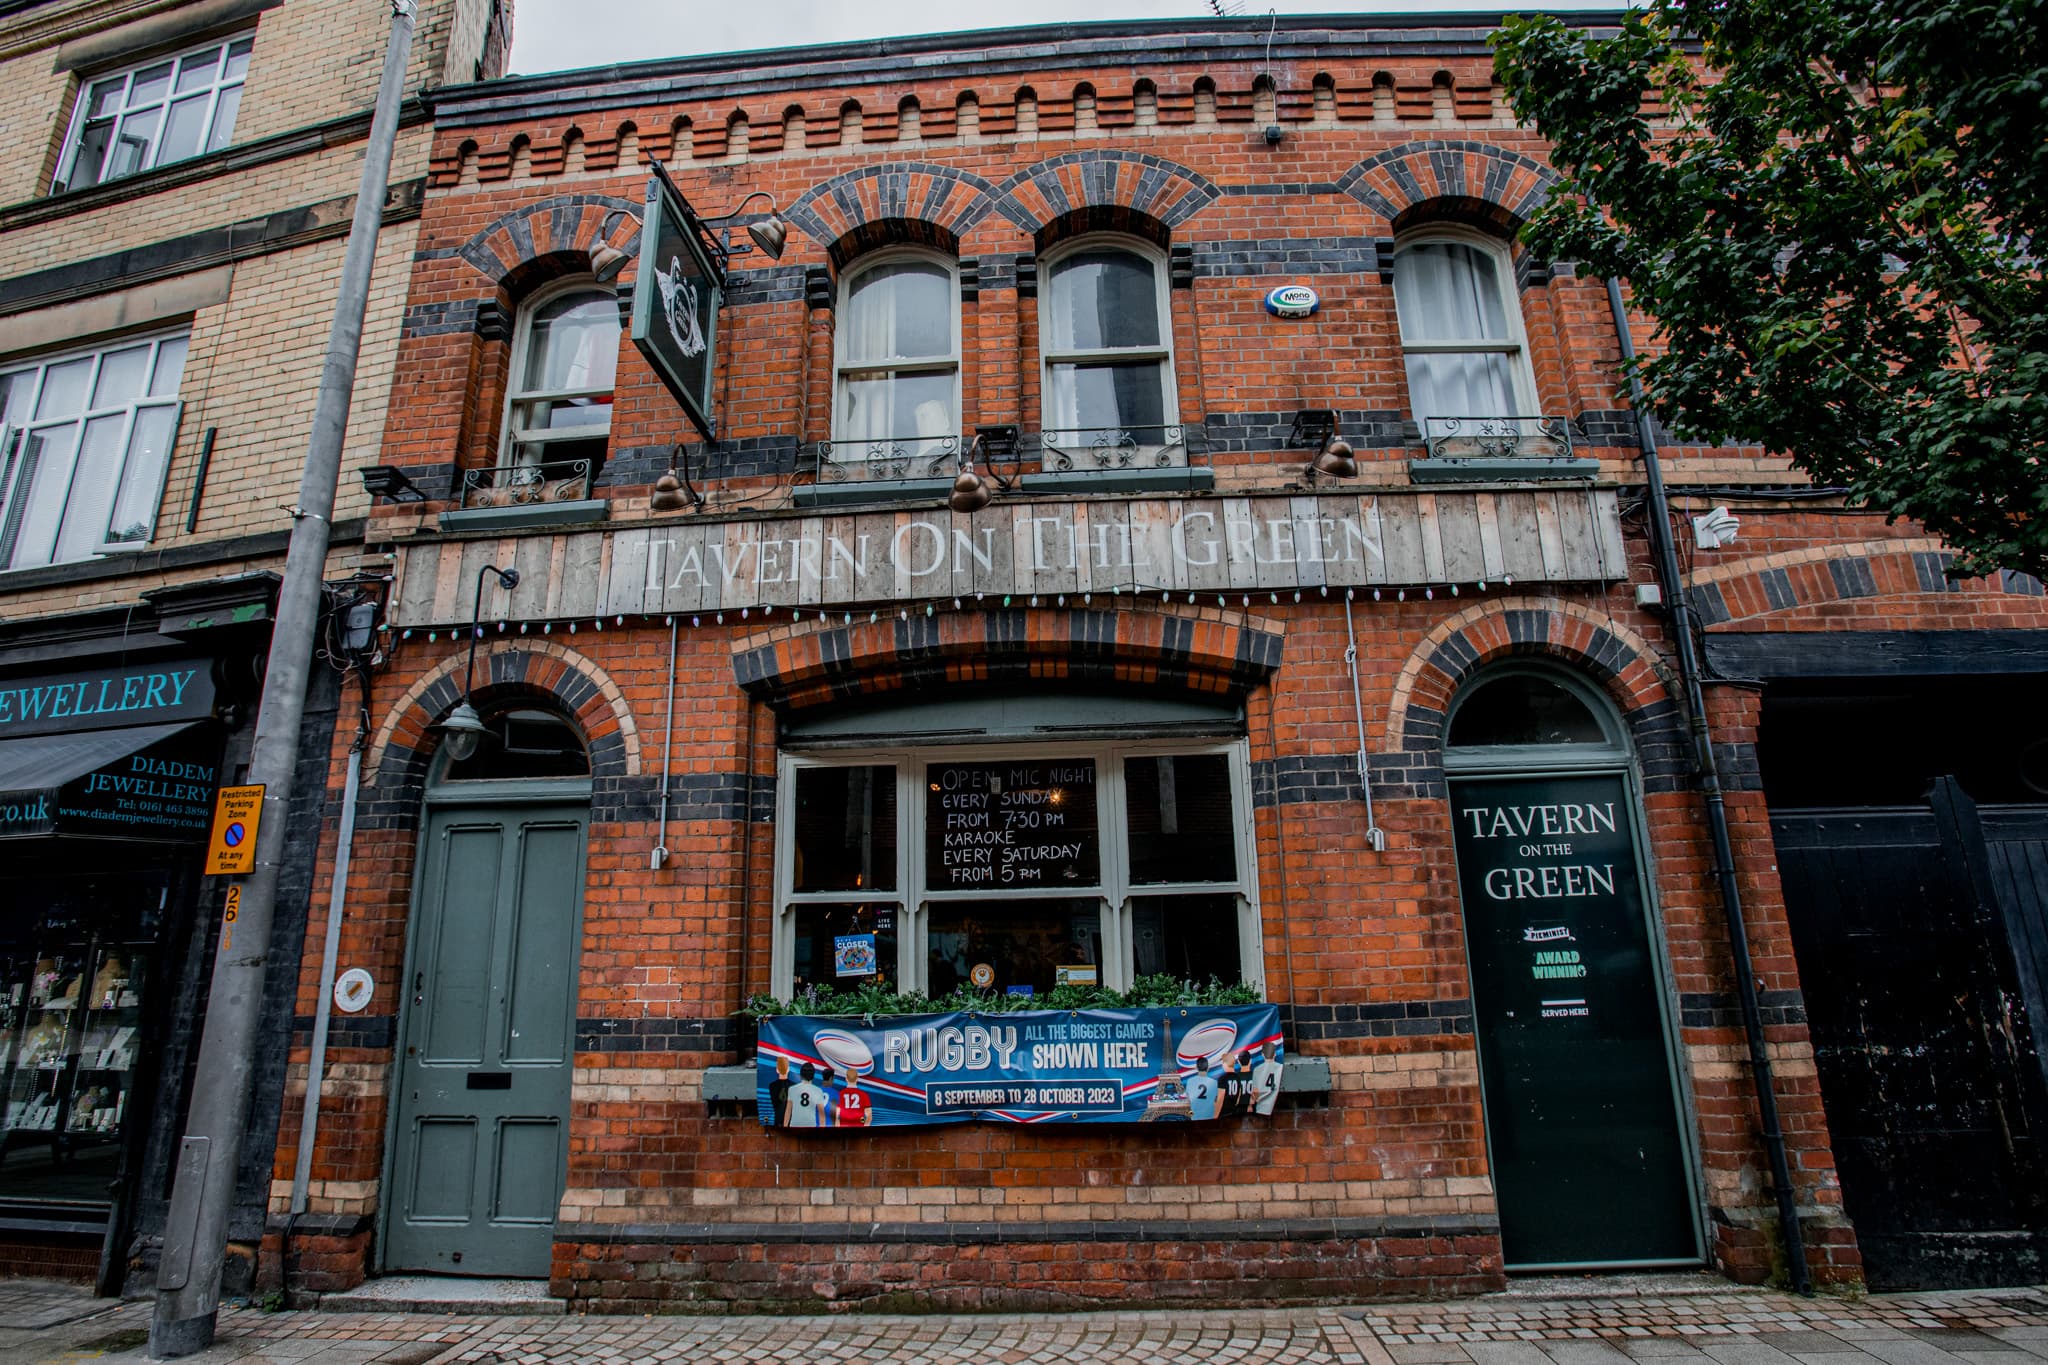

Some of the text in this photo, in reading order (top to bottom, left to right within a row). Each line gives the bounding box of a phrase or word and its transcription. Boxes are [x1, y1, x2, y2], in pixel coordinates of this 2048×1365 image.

[633, 511, 1386, 591] TAVERN ON THE GREEN
[131, 756, 214, 782] DIADEM
[943, 766, 1094, 790] OPEN MIC NIGHT
[85, 773, 212, 802] JEWELLERY
[222, 789, 262, 799] Restricted
[117, 798, 136, 810] Tel:
[139, 801, 162, 812] 0161
[165, 804, 183, 814] 465
[225, 800, 254, 809] Parking
[943, 788, 1062, 808] EVERY SUNDAY
[59, 807, 207, 829] www.diademjewellery.co.uk
[228, 810, 247, 818] Zone
[947, 810, 1064, 829] FROM 7:30 PM
[1463, 802, 1616, 838] TAVERN
[944, 830, 1016, 846] KARAOKE
[218, 851, 243, 860] At any
[944, 842, 1082, 865] EVERY SATURDAY
[1519, 843, 1573, 857] ON THE
[220, 862, 238, 870] time
[952, 864, 1040, 883] FROM 5 PM
[1484, 864, 1615, 900] GREEN
[837, 941, 868, 949] CLOSED
[1536, 951, 1580, 965] AWARD
[1541, 1007, 1589, 1018] SERVED HERE!
[1025, 1023, 1154, 1041] ALL THE BIGGEST GAMES
[883, 1025, 1018, 1074] RUGBY
[1032, 1042, 1149, 1069] SHOWN HERE
[1228, 1079, 1238, 1096] 10
[1265, 1072, 1276, 1091] 4
[800, 1092, 810, 1107] 8
[934, 1087, 1115, 1105] 8 SEPTEMBER TO 28 OCTOBER 2023
[1197, 1084, 1207, 1099] 2
[843, 1093, 860, 1109] 12
